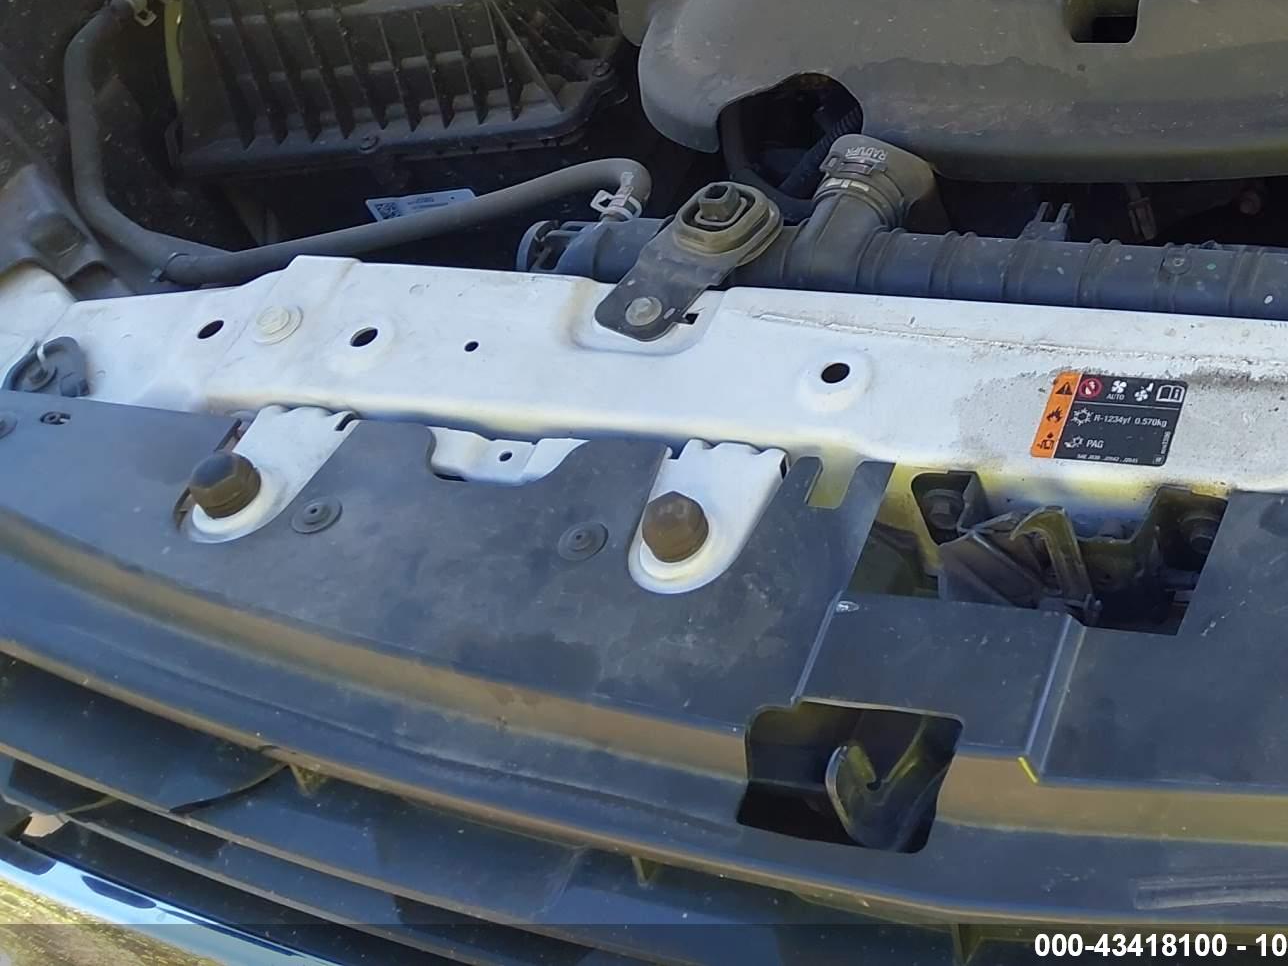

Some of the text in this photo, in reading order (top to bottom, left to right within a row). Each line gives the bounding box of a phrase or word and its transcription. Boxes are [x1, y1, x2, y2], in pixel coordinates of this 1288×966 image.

[1106, 393, 1125, 401] AUTO
[1093, 414, 1168, 428] R-1234yf 0.570kg
[1086, 439, 1104, 449] PAG
